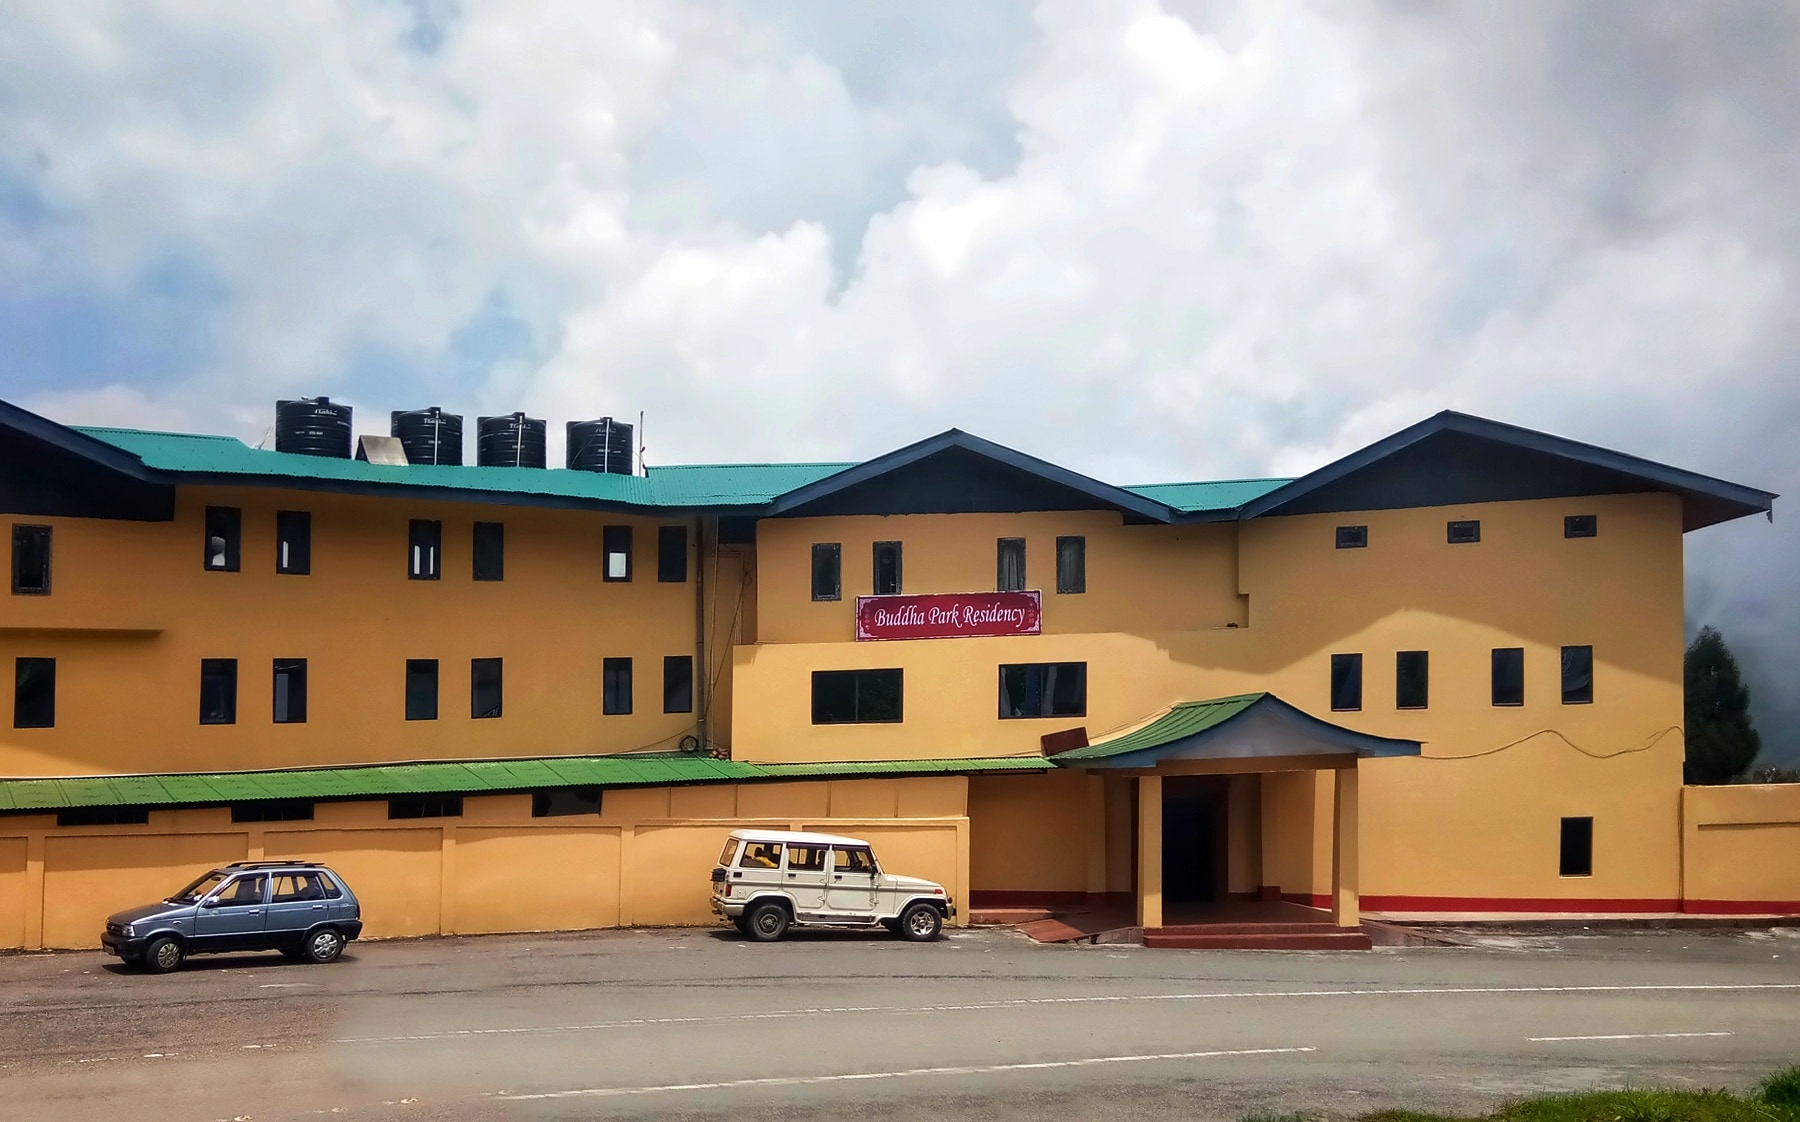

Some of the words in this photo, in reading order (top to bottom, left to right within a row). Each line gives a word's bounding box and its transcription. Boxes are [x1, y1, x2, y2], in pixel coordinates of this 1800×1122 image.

[874, 605, 925, 627] Buddha
[928, 603, 962, 628] Park
[962, 602, 1025, 628] Residency
